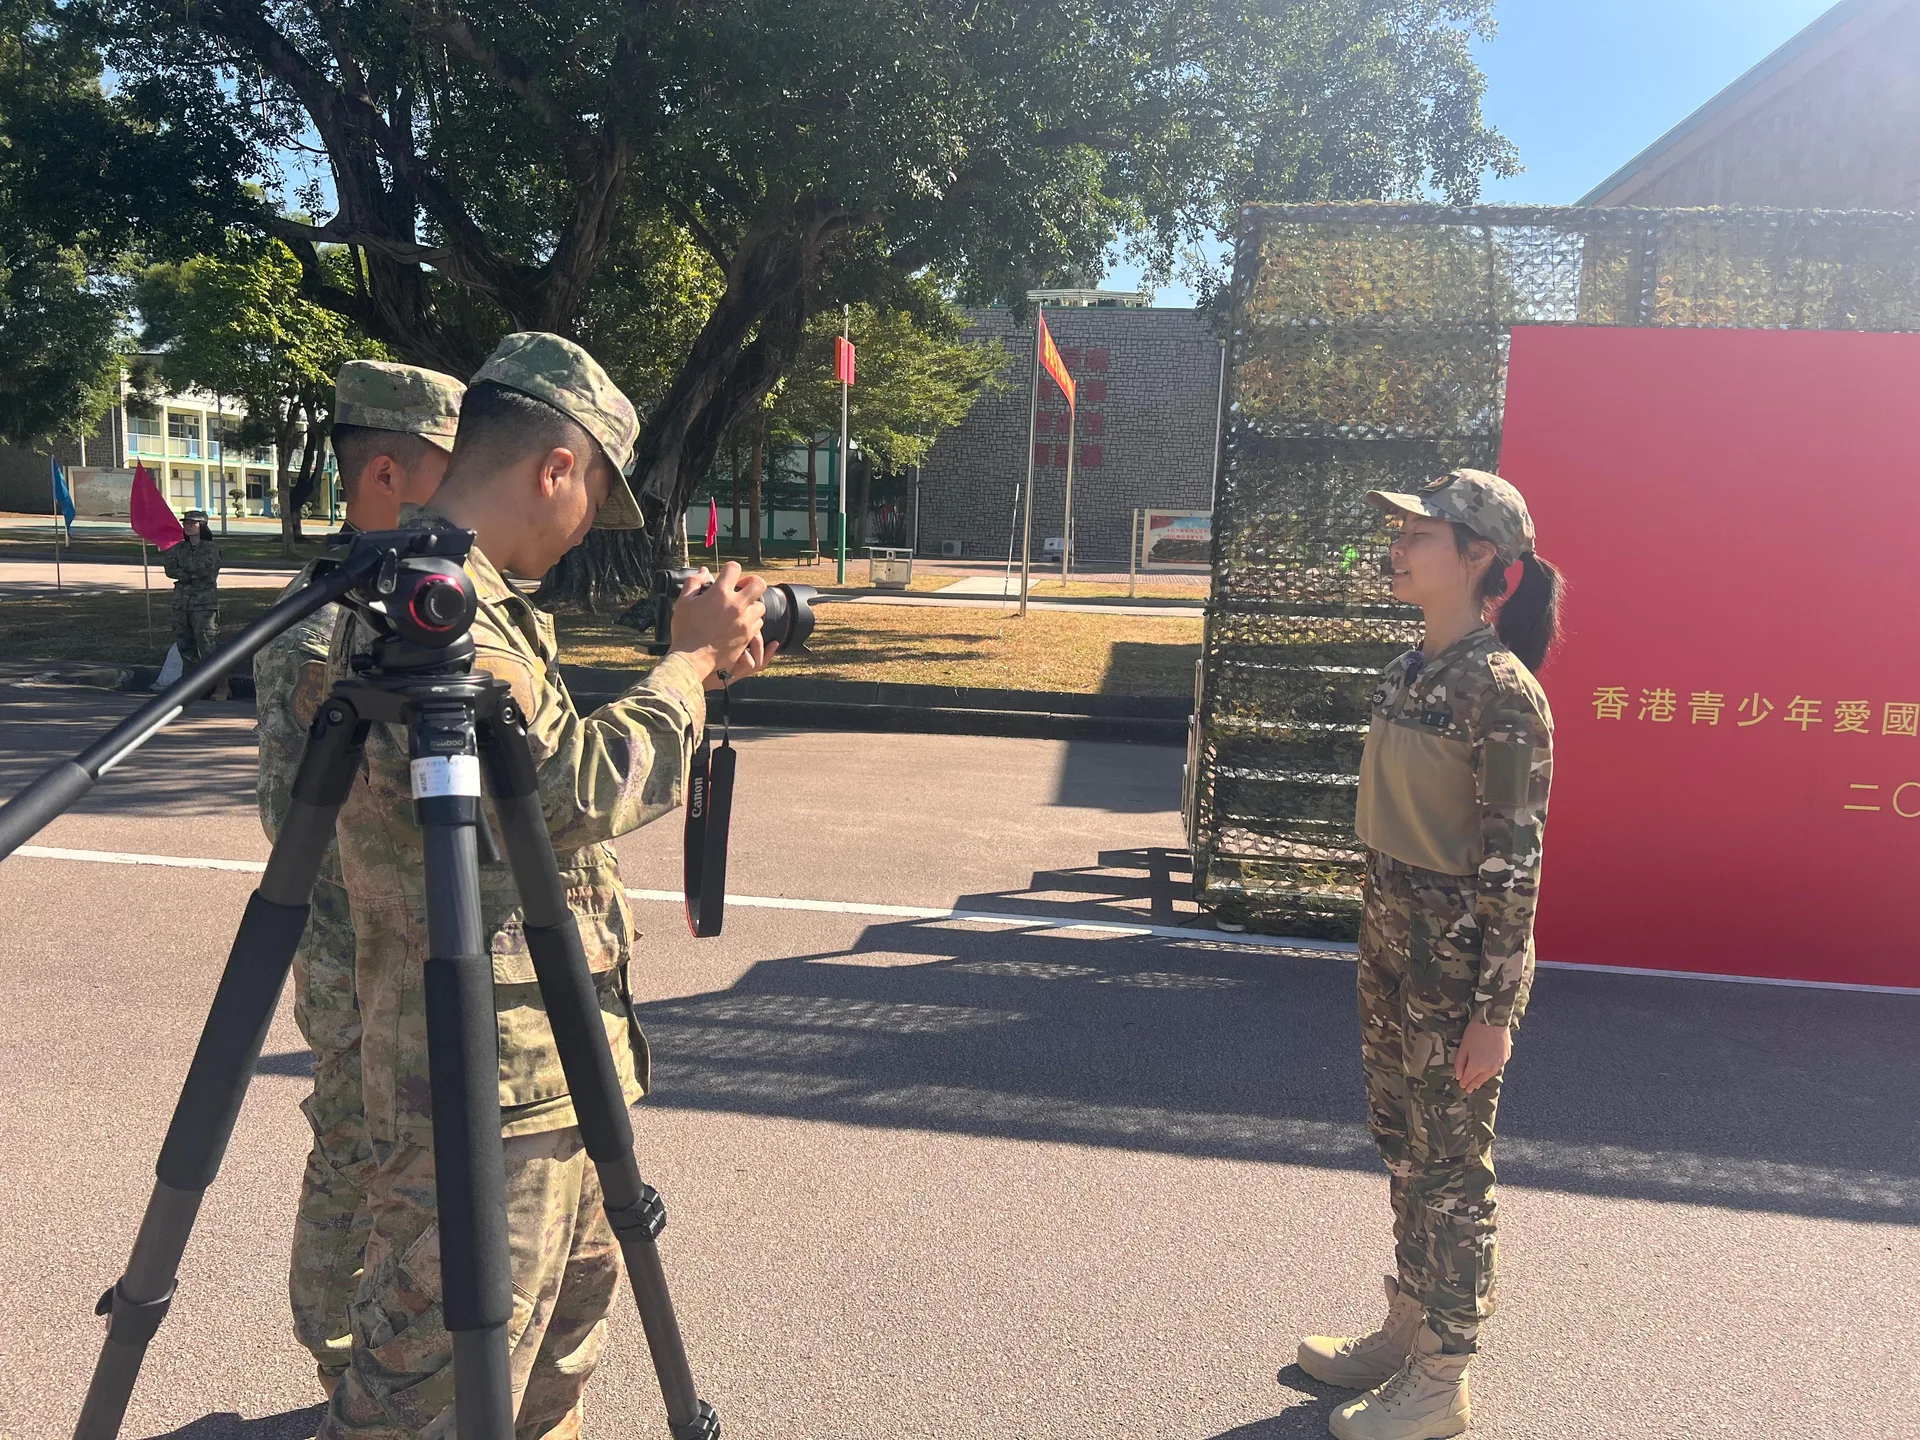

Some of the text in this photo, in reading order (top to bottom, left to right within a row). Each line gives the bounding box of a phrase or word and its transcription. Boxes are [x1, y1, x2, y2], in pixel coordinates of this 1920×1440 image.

[1591, 686, 1920, 737] 香港青少年愛國
[692, 777, 703, 818] Canon
